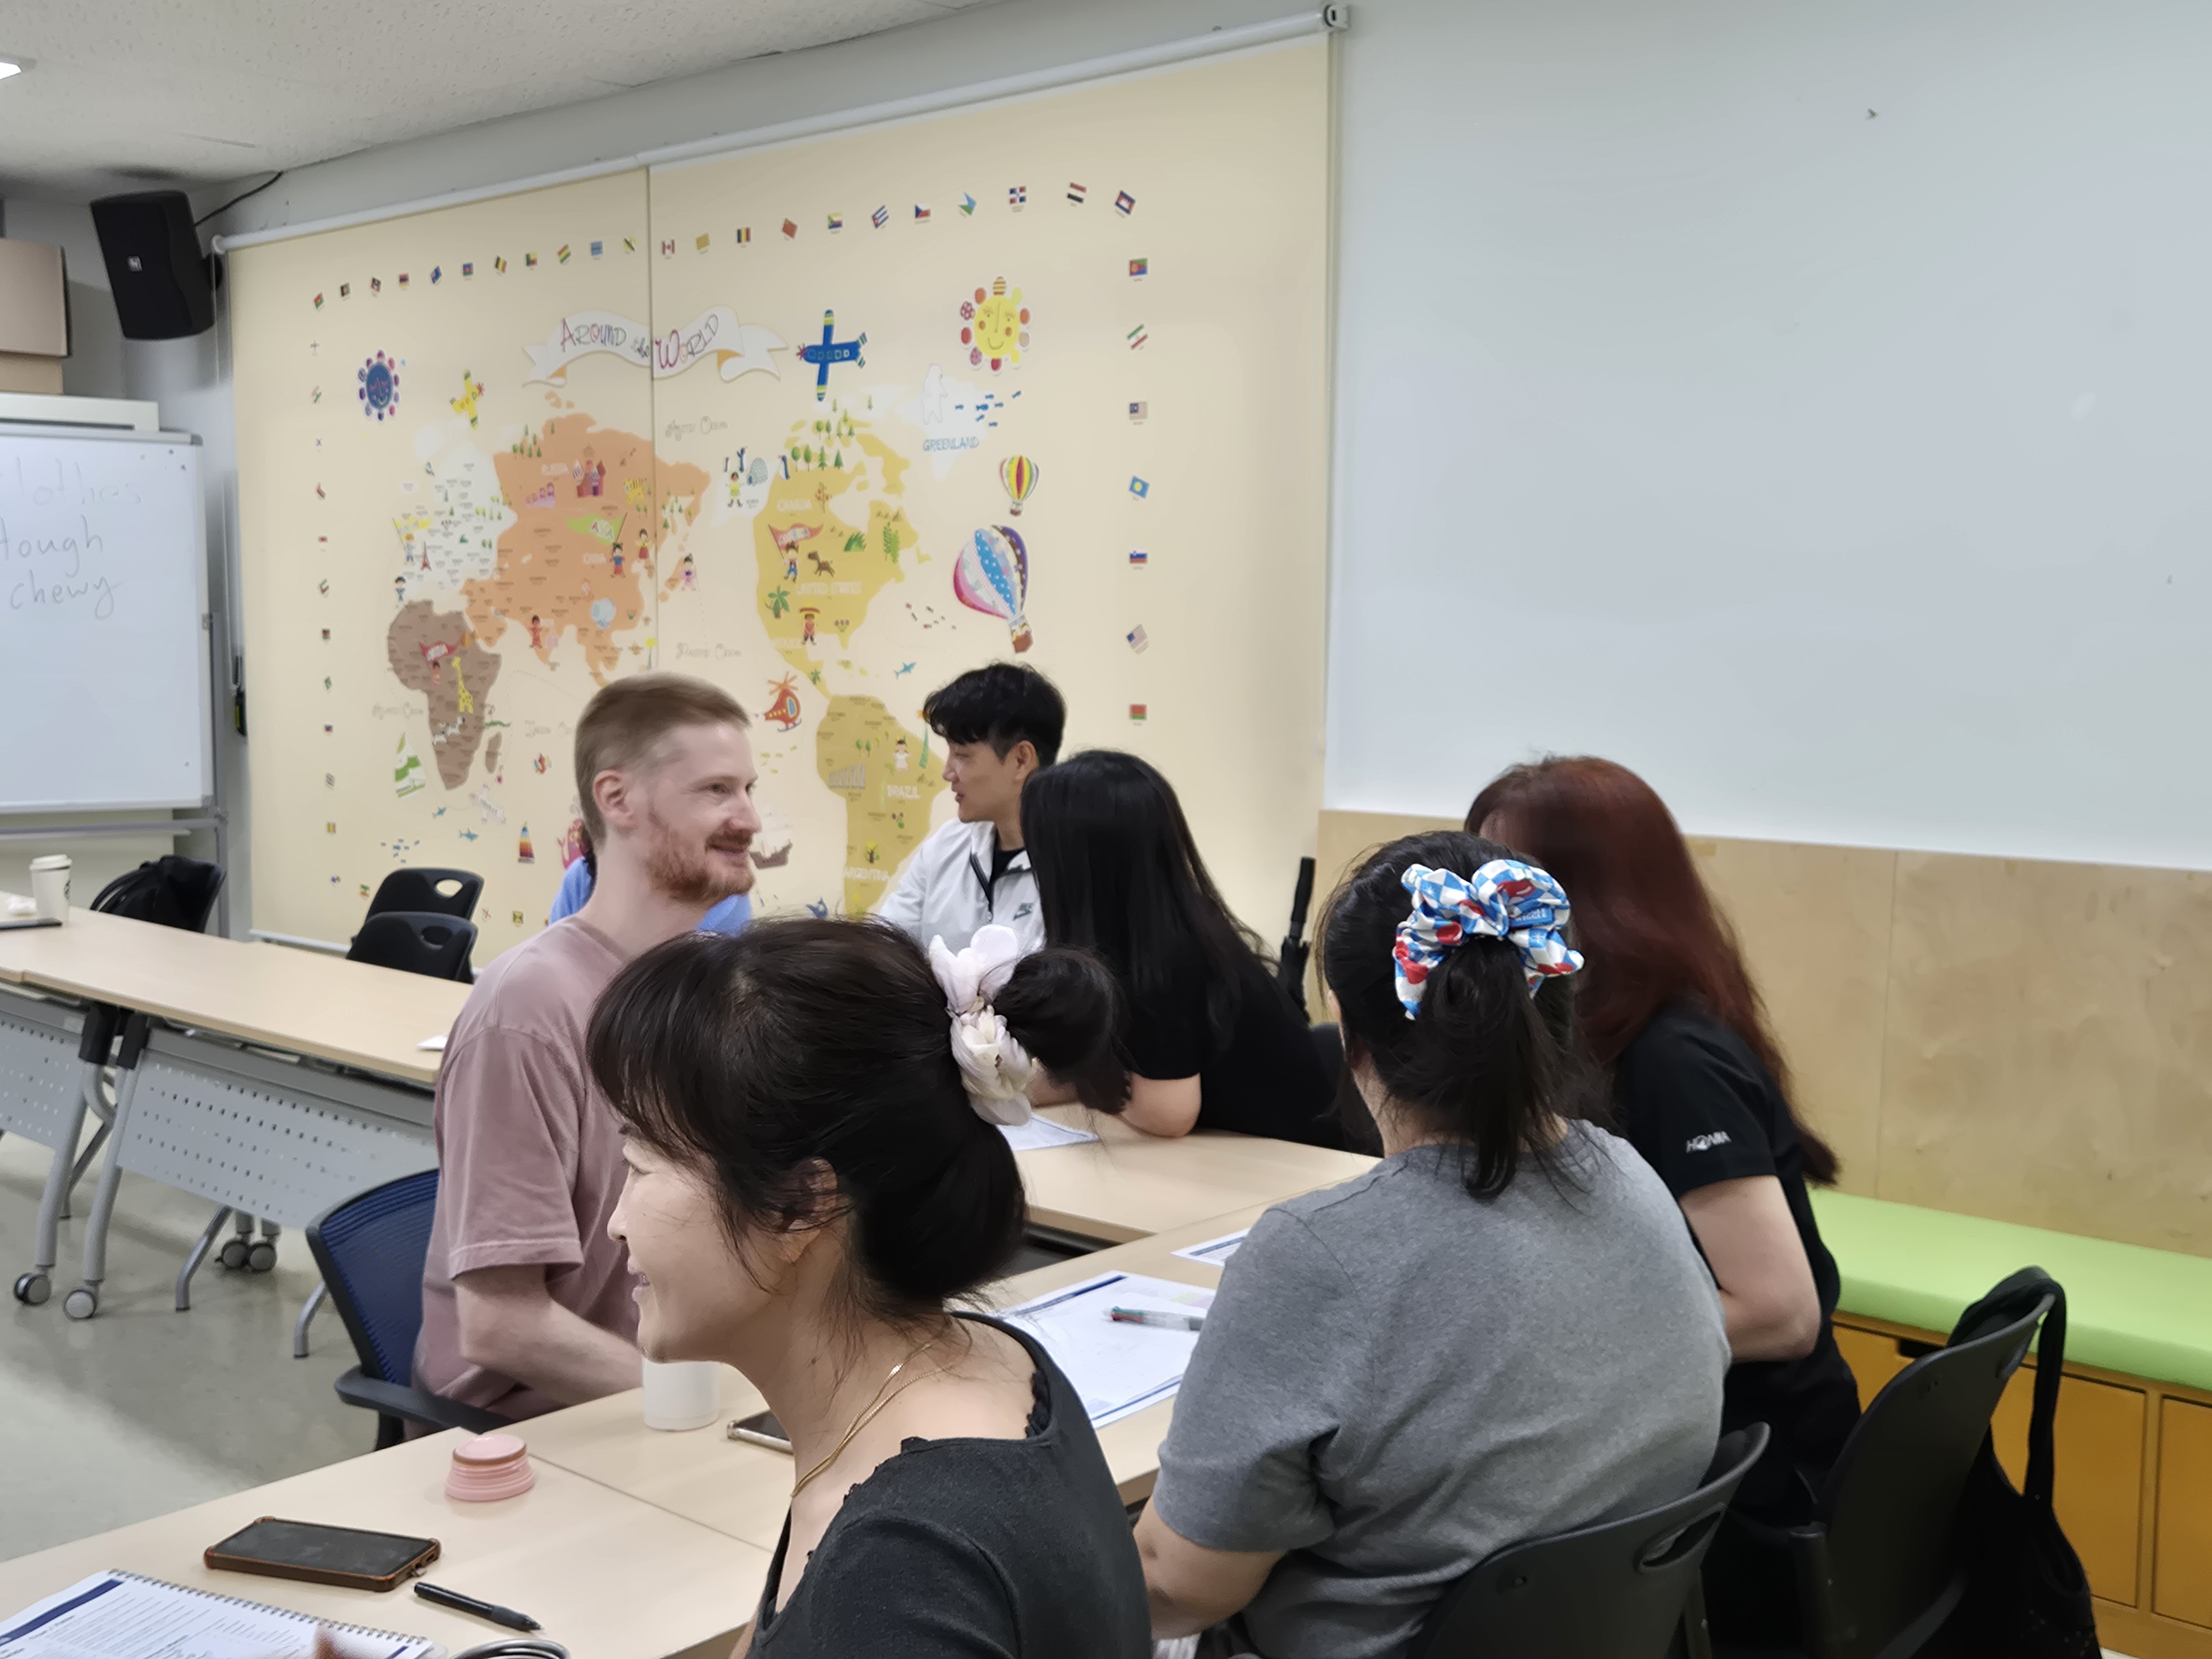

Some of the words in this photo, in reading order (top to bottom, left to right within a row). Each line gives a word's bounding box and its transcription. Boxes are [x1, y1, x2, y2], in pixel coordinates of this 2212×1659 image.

[560, 317, 627, 352] AROUND
[651, 314, 719, 369] WORLD
[922, 435, 979, 452] GREENLAND
[0, 455, 142, 506] lothes
[9, 568, 127, 620] chewy
